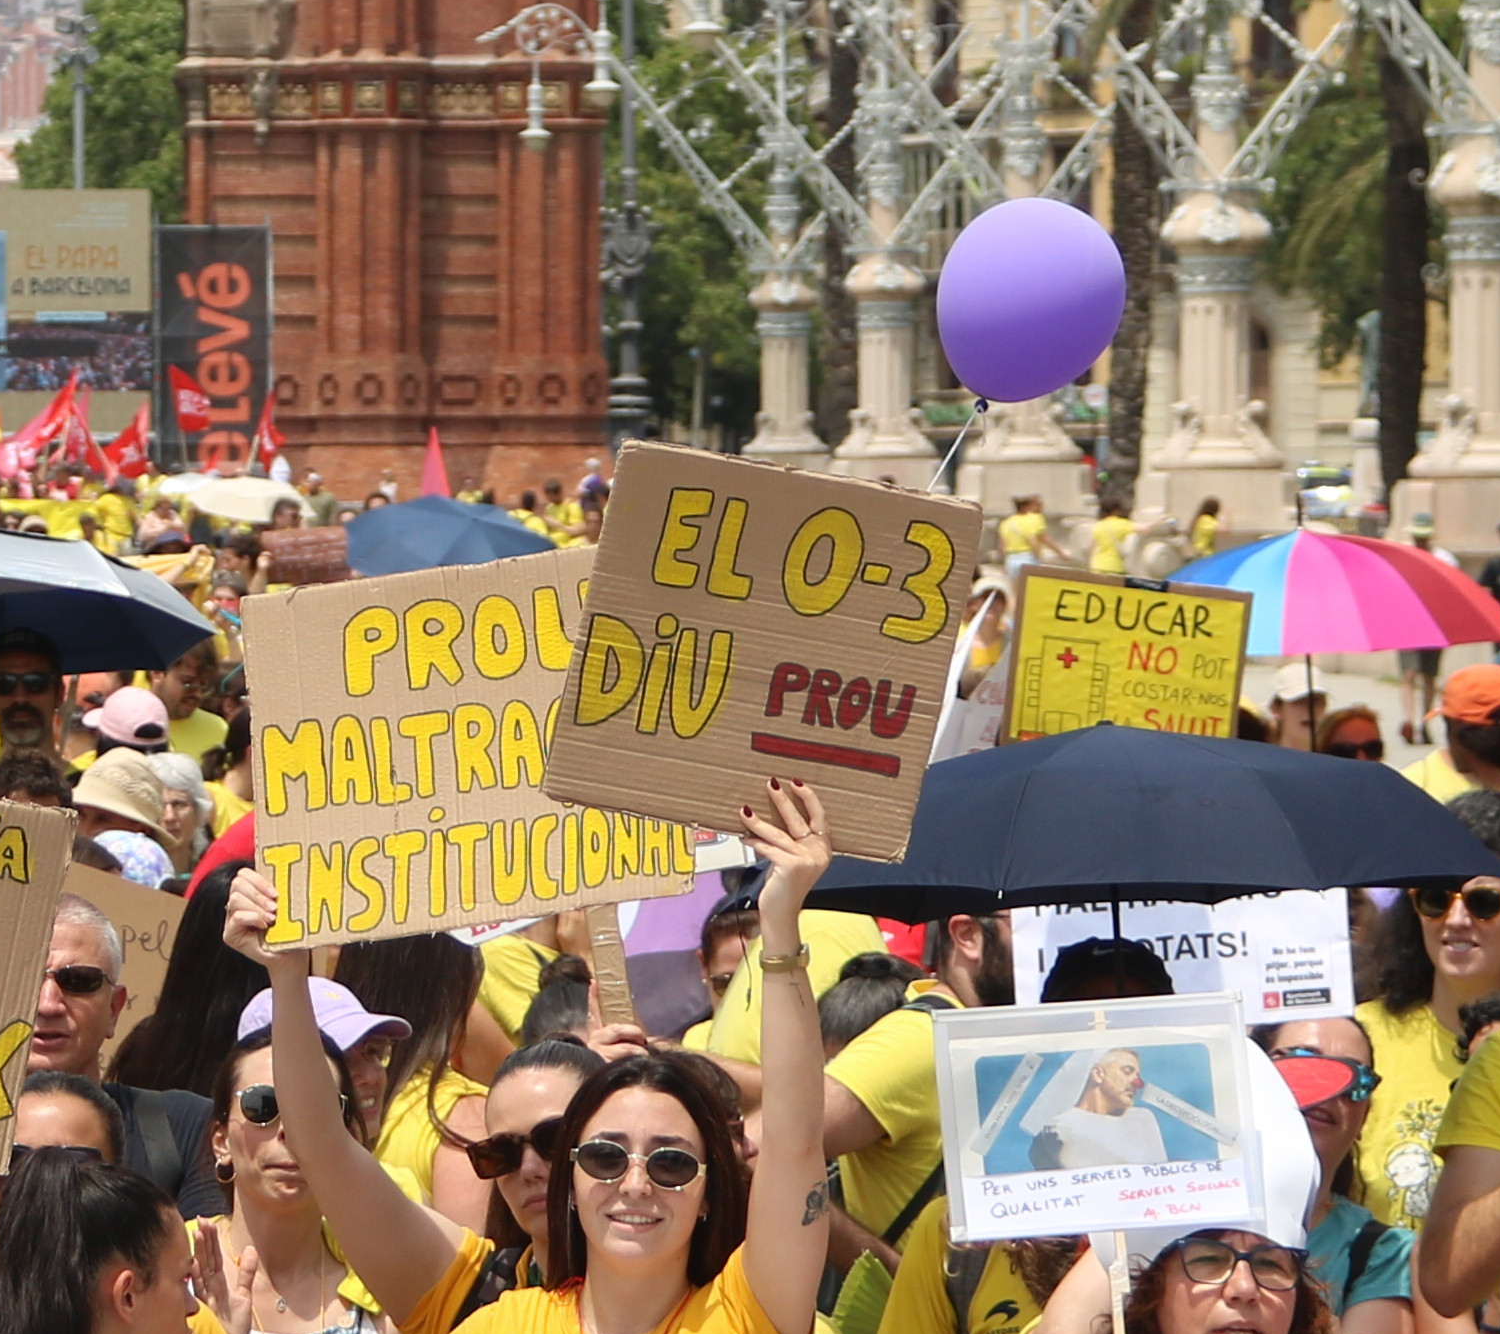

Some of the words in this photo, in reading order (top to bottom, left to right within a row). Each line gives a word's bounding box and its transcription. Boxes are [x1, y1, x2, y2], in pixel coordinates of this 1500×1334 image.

[25, 245, 47, 269] EL
[55, 245, 119, 269] PAPA
[29, 276, 131, 296] BARCELONA
[651, 486, 753, 601] EL
[1054, 589, 1215, 639] EDUCAR
[1127, 640, 1179, 676] NO
[1191, 653, 1231, 681] POT
[764, 661, 918, 742] PROU
[1026, 1175, 1058, 1190] UNS
[1070, 1167, 1132, 1186] SERVEIS
[1142, 1161, 1198, 1178] PÚBLICS
[1206, 1158, 1223, 1172] DE
[990, 1194, 1085, 1219] QUALITAT
[1119, 1184, 1176, 1202] SERVEIS
